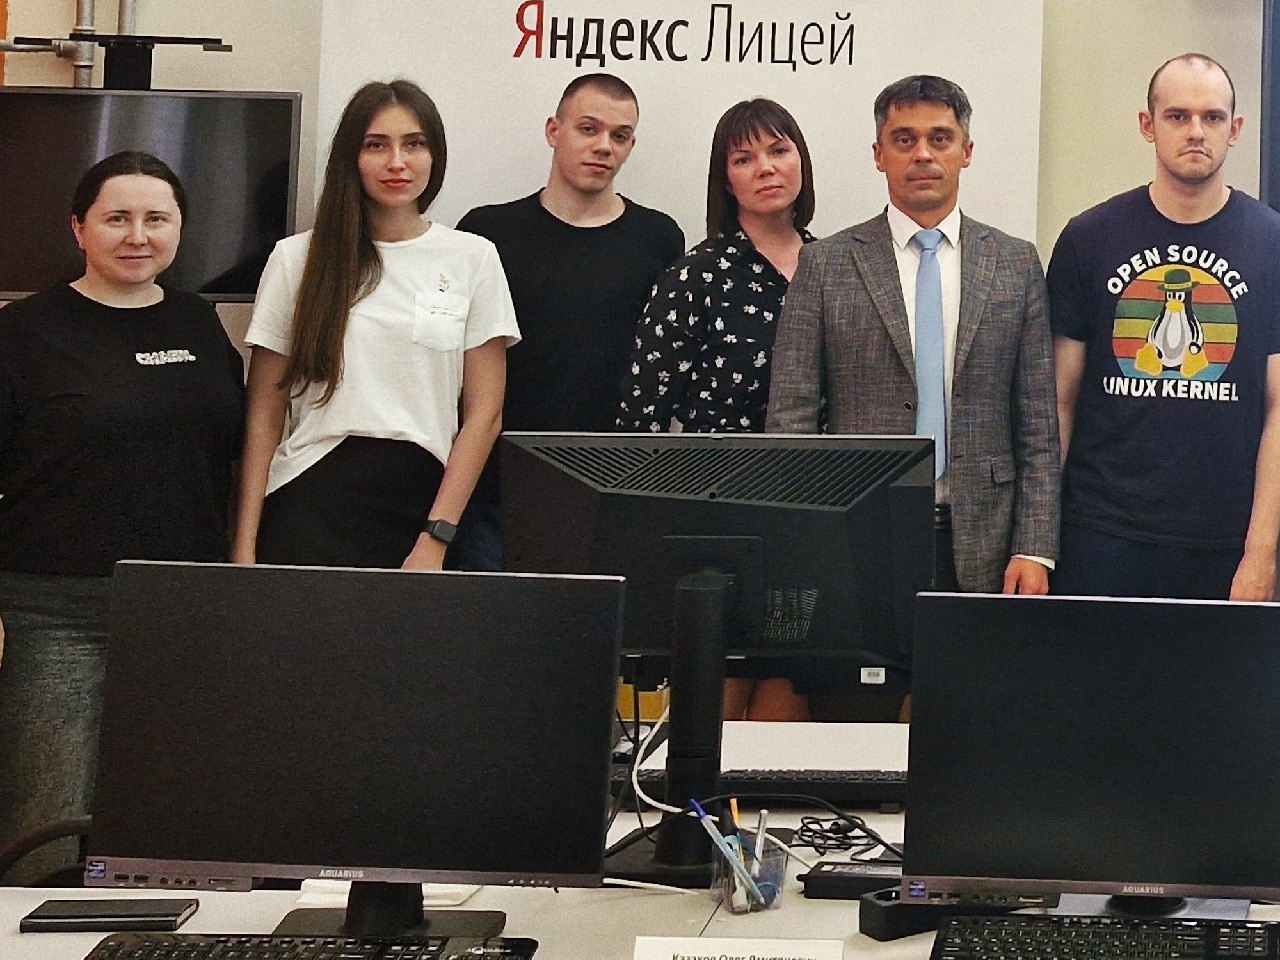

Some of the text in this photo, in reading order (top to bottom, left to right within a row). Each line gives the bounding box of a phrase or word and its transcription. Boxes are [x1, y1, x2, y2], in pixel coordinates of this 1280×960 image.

[701, 2, 855, 72] Лицей
[1107, 244, 1249, 300] OPEN SOURCE
[1103, 376, 1238, 402] LINUX KERNEL
[319, 869, 365, 878] AQUARIUS
[1122, 885, 1165, 895] AQUARIUS
